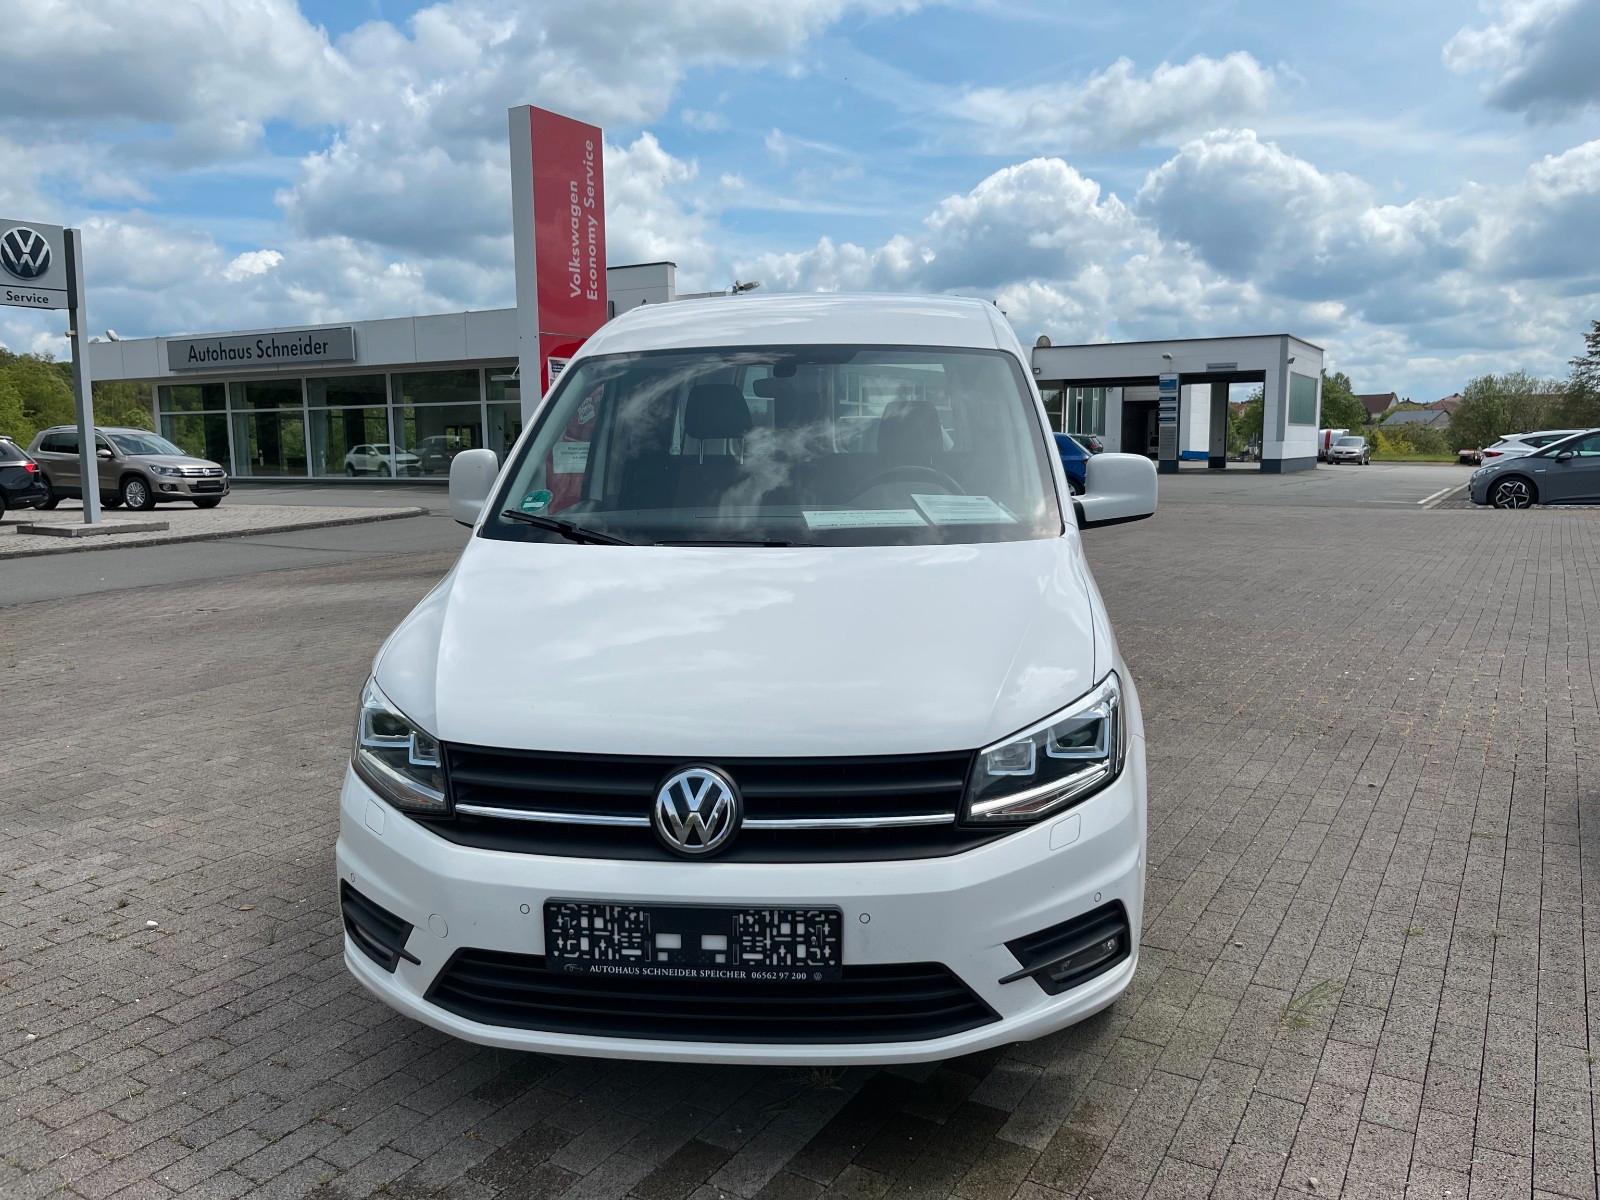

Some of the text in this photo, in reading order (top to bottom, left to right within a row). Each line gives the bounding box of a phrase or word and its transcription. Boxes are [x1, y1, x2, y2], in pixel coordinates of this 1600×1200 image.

[584, 140, 598, 300] Economy Service
[569, 180, 581, 297] Volkswagen
[6, 290, 49, 304] Service
[188, 335, 329, 362] Autohaus Schneider
[589, 965, 640, 975] AUTOHAUS
[642, 967, 697, 977] SCHNEIDER
[699, 969, 747, 979] SPEICHER
[751, 971, 777, 980] 06562
[779, 972, 789, 980] 97
[791, 972, 807, 980] 200
